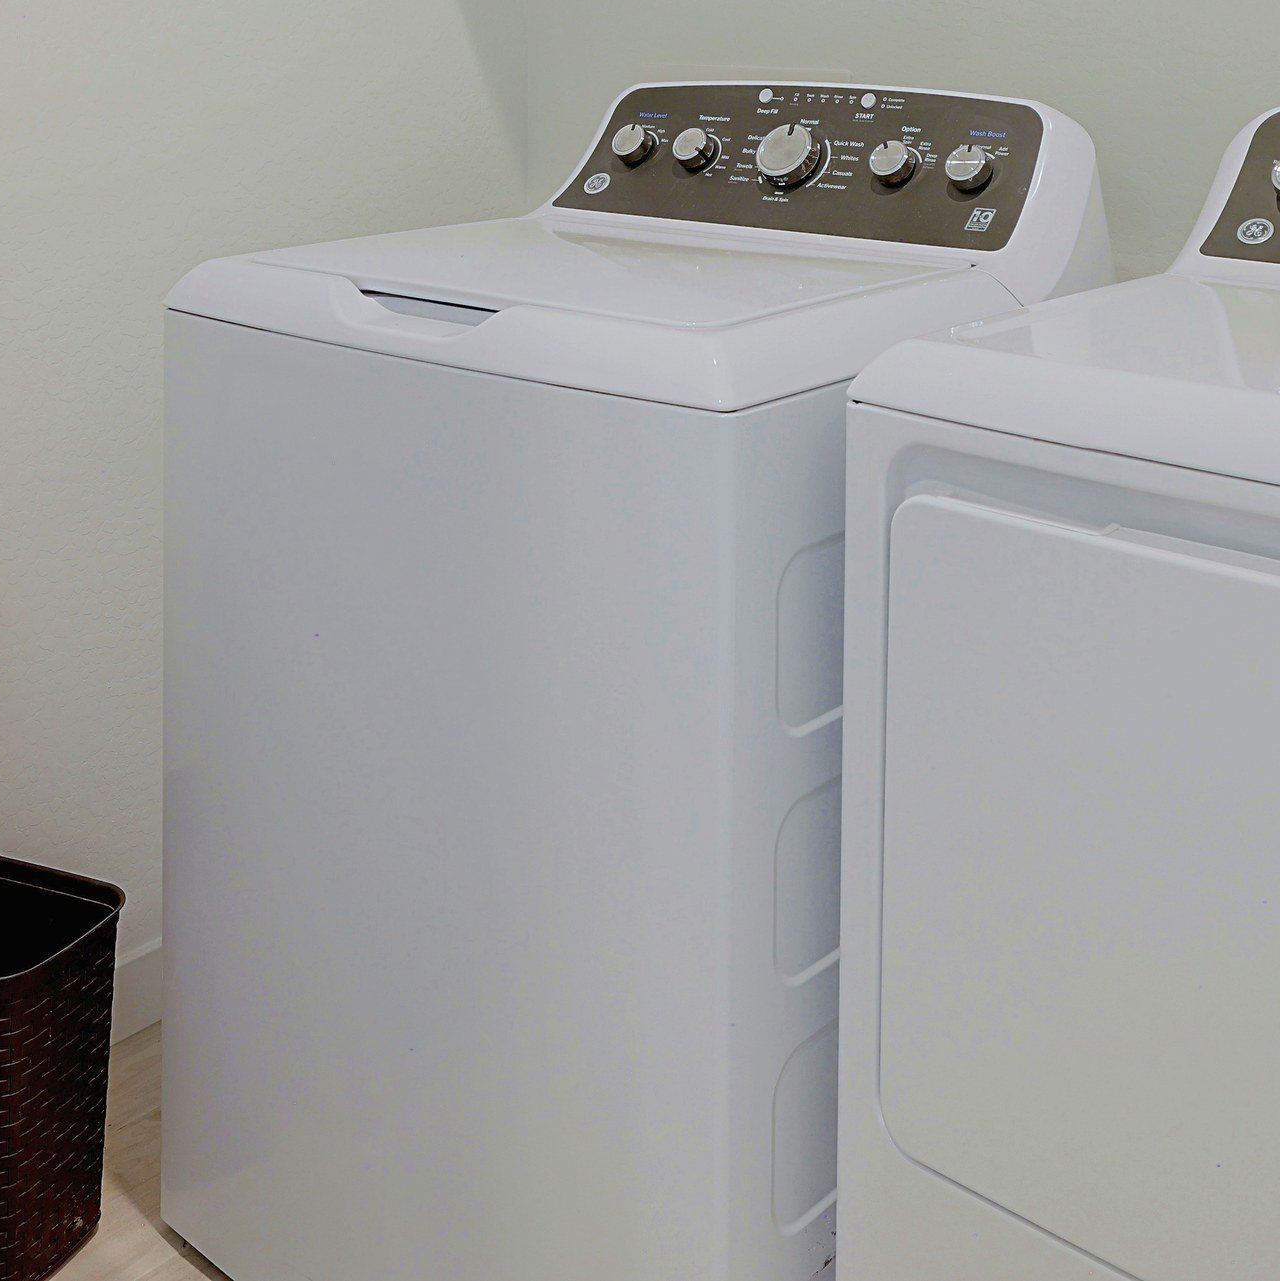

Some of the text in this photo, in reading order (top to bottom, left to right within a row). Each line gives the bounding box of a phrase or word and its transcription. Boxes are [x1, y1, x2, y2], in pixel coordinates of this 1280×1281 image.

[698, 114, 731, 122] Temperature
[969, 129, 1006, 138] Wash Boost
[847, 140, 865, 148] Wash
[840, 154, 859, 162] Whites
[817, 182, 847, 190] Activewear
[972, 210, 993, 222] 10
